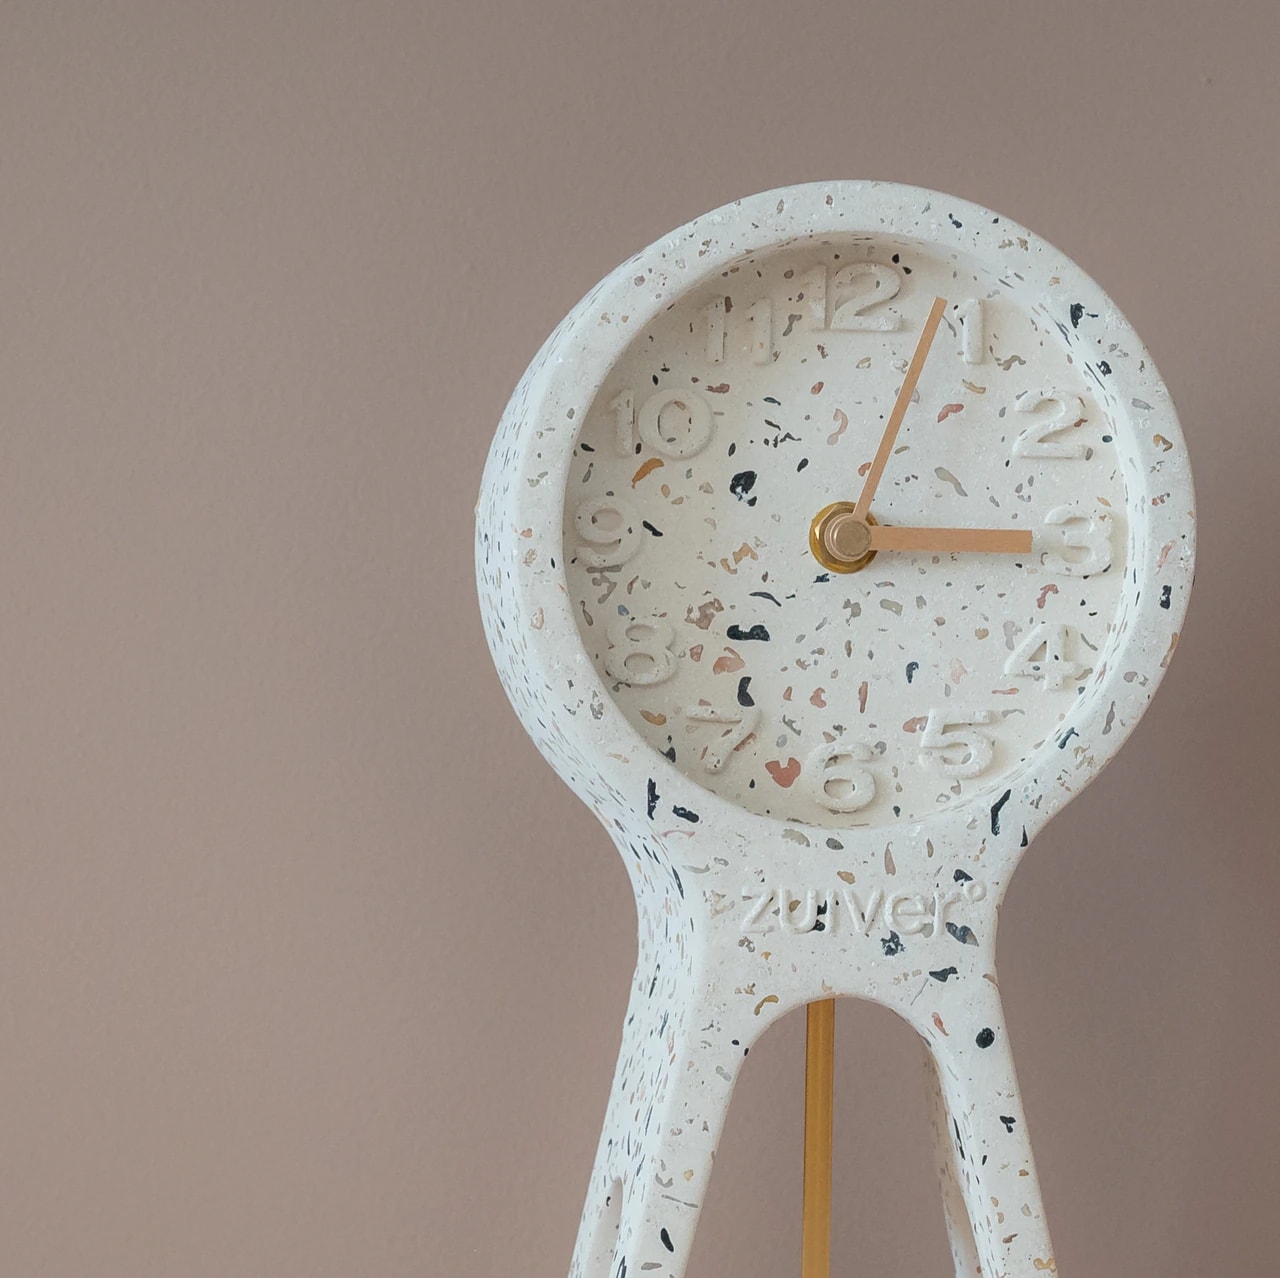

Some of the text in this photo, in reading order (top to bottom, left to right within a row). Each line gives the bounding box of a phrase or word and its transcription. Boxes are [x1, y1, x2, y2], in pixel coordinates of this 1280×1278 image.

[801, 262, 904, 332] 12
[953, 298, 986, 365] 1
[610, 388, 713, 460] 10
[1014, 390, 1086, 459] 2
[574, 498, 642, 568] 9
[1044, 504, 1115, 576] 3
[604, 615, 677, 686] 8
[1004, 623, 1079, 690] 4
[685, 705, 761, 775] 7
[918, 707, 996, 779] 5
[810, 742, 876, 812] 6
